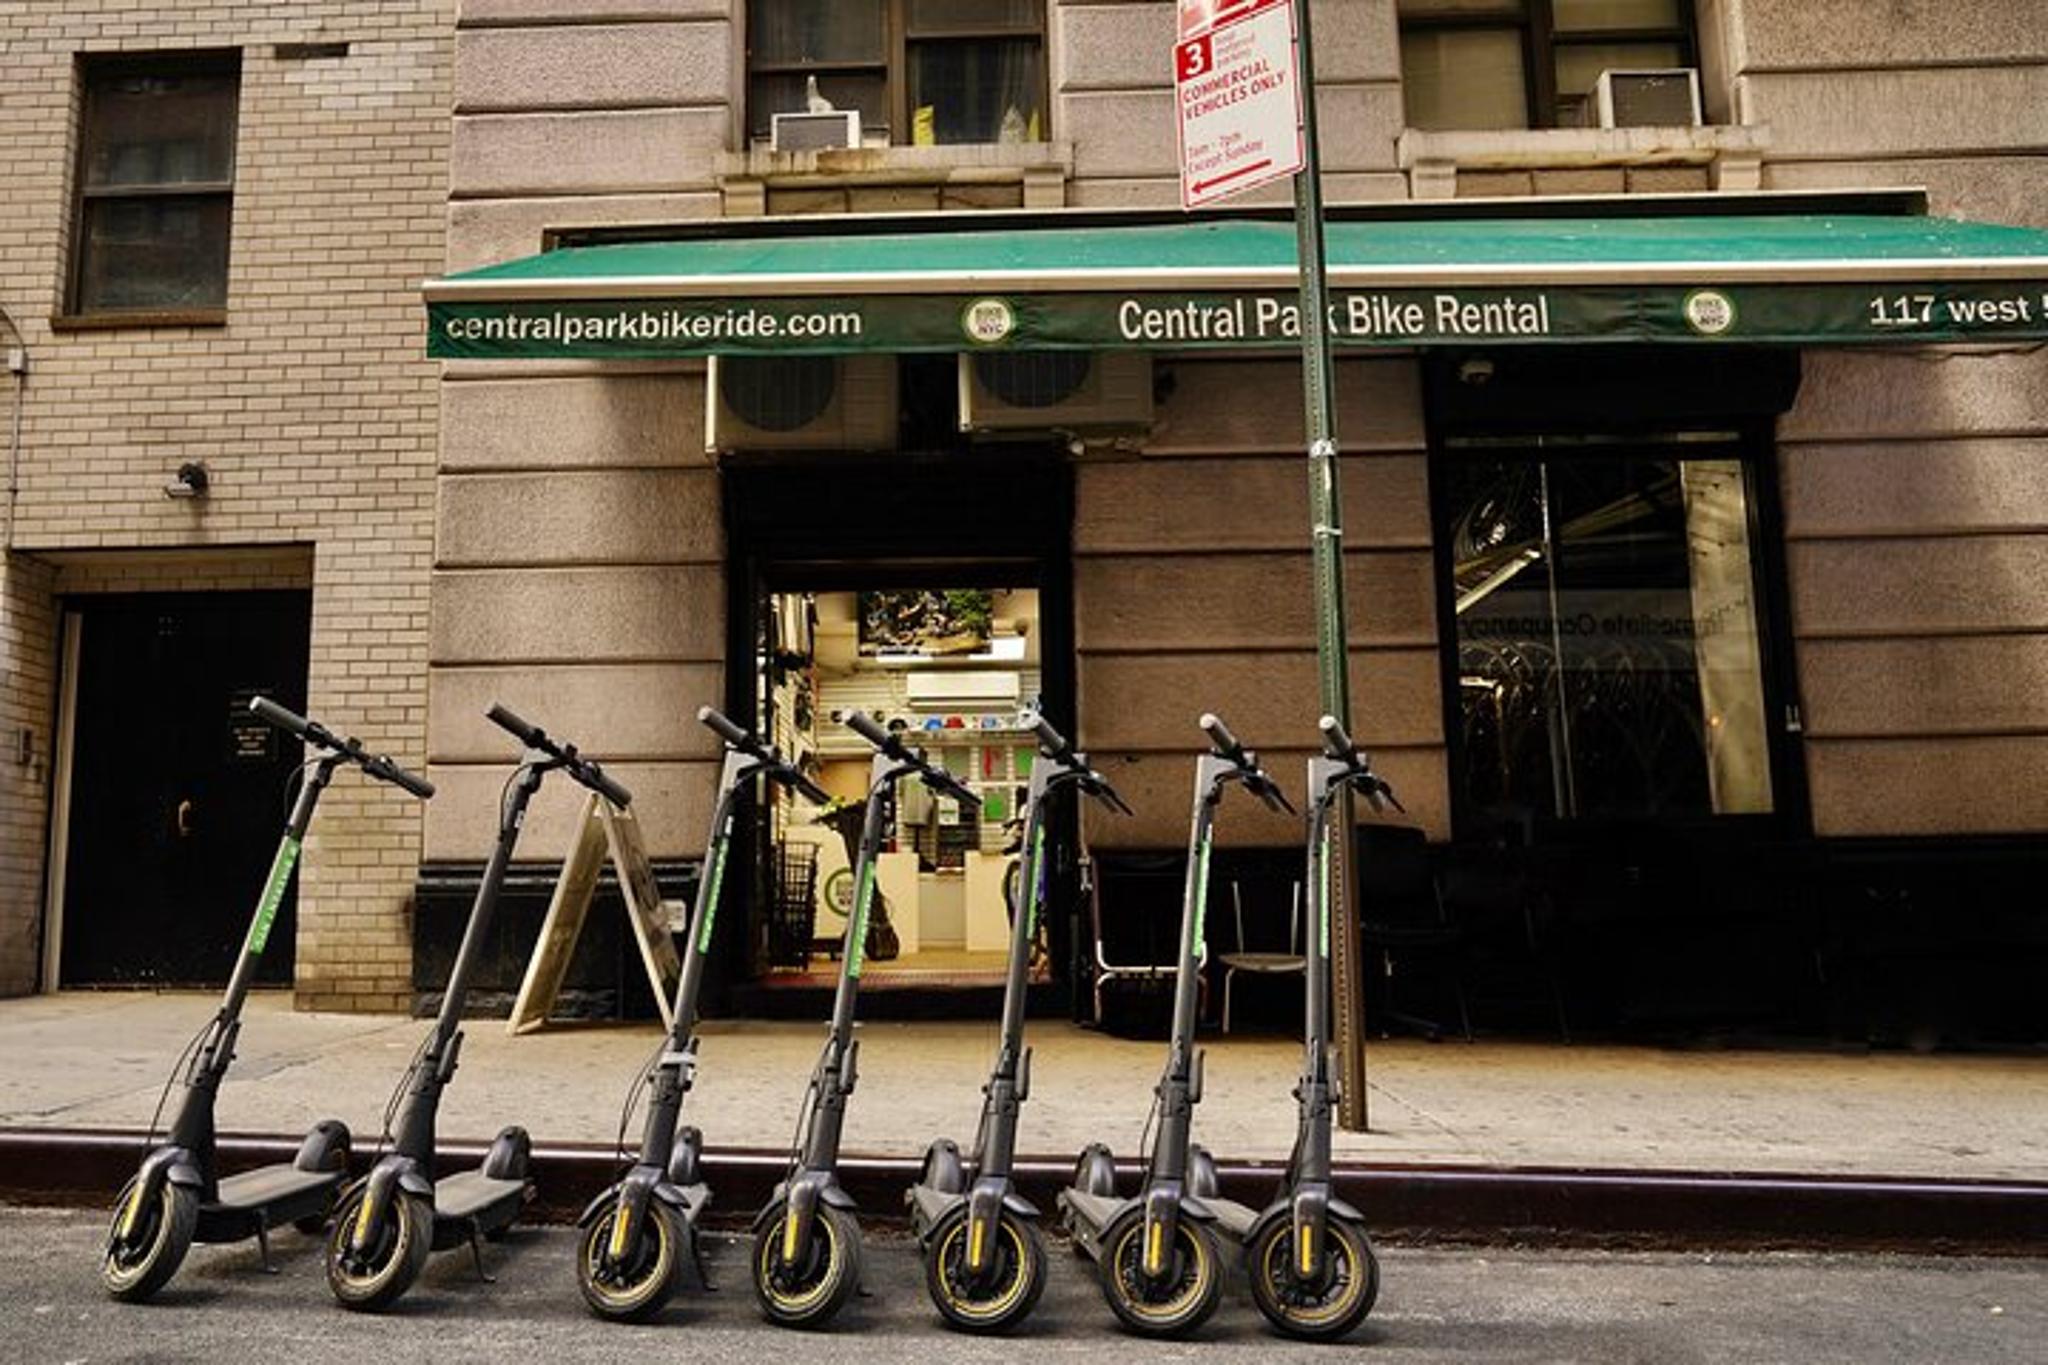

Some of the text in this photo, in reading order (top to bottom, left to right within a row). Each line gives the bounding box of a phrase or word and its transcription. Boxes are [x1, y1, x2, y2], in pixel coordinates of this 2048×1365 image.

[1185, 42, 1204, 76] 3
[1183, 58, 1270, 104] COMMERCIAL
[1185, 71, 1286, 120] VEHICLES ONLY
[446, 309, 861, 344] centralparkbikeride.com
[1119, 294, 1549, 340] Central Pak Bike Rental
[1869, 295, 1936, 326] 117
[1947, 296, 2032, 323] west
